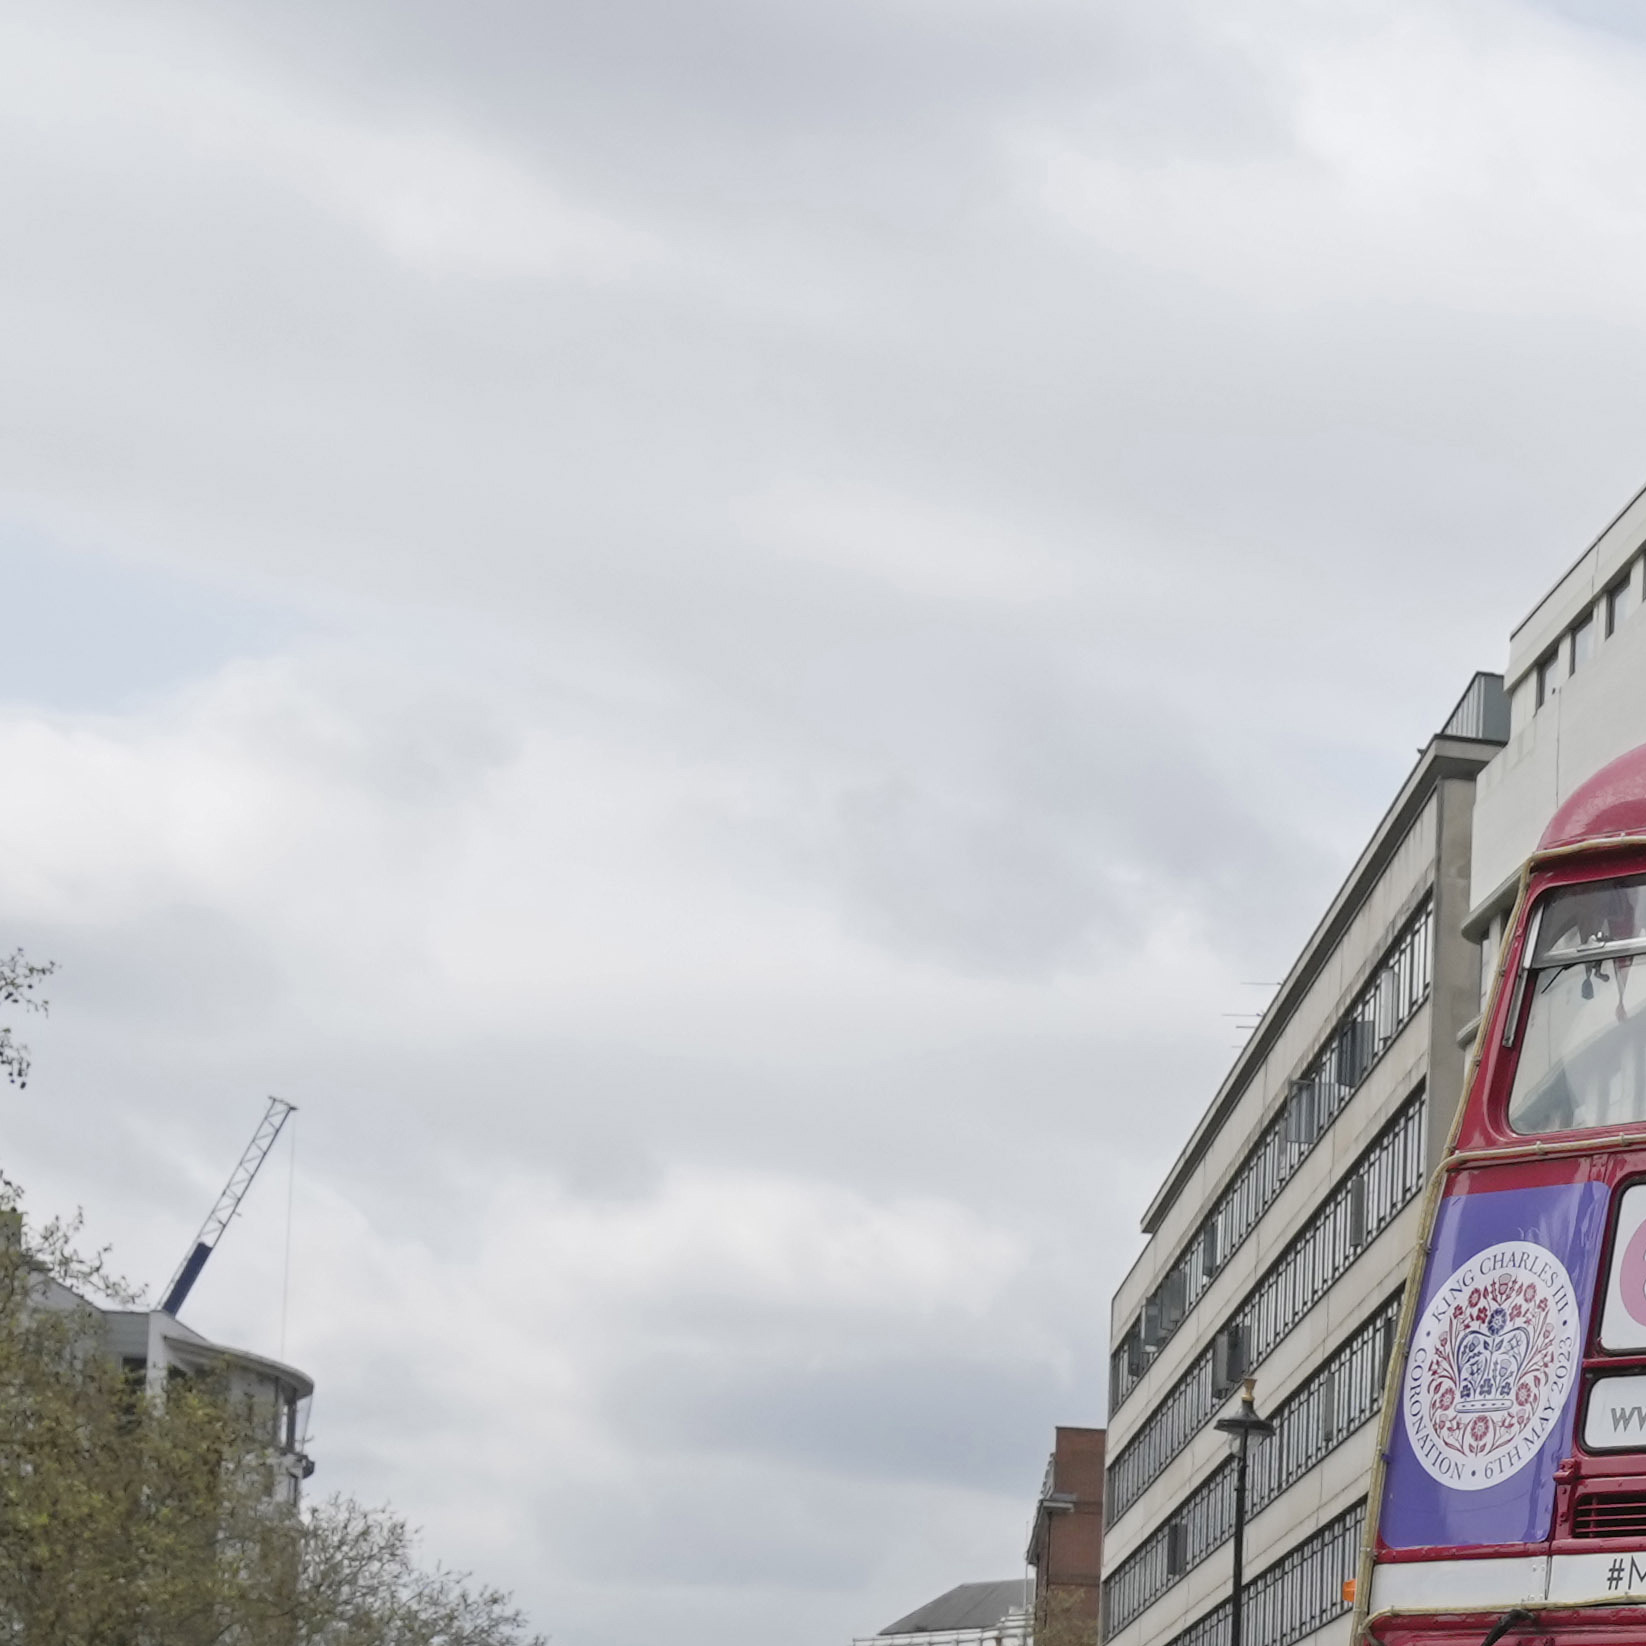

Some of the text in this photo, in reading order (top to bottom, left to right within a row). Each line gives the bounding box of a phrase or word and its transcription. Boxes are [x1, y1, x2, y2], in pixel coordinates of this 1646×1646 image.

[1432, 1251, 1570, 1323] KING CHARLES III
[1409, 1347, 1466, 1480] CORONATION
[1484, 1336, 1573, 1480] 6TH MAY 2023
